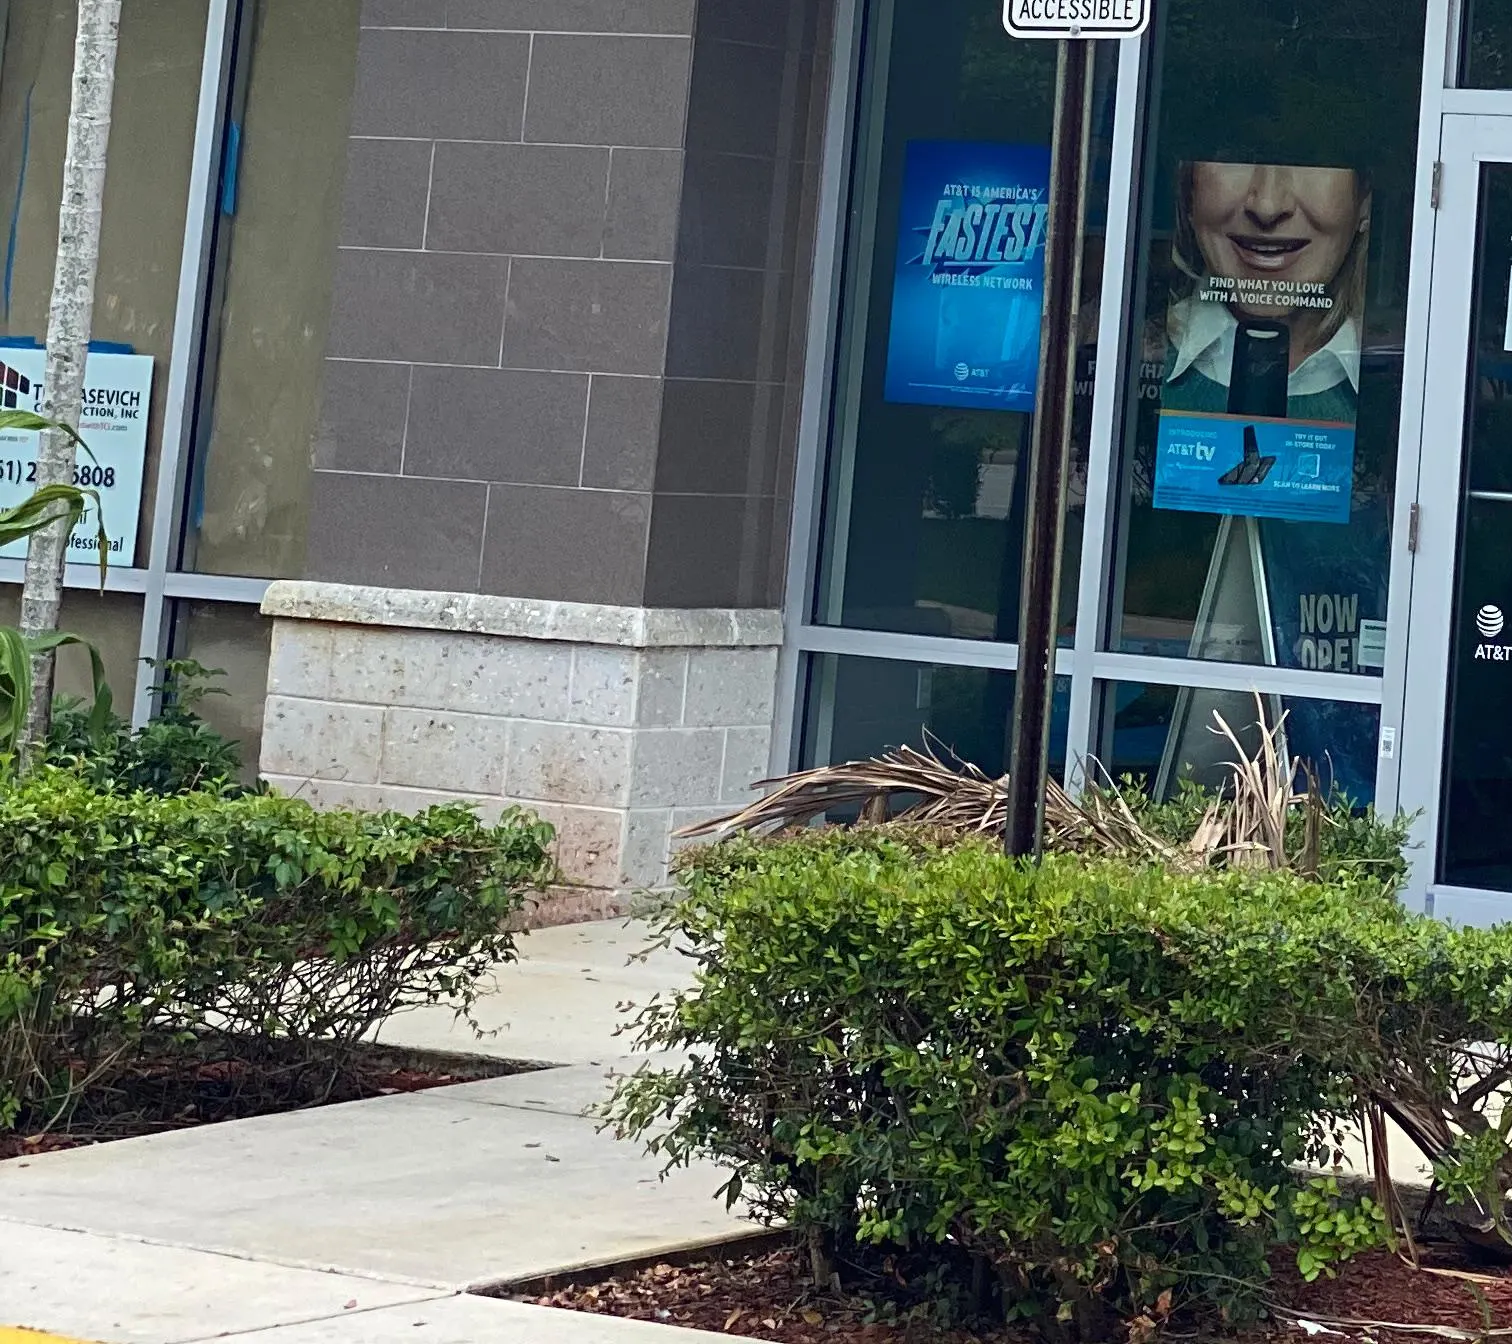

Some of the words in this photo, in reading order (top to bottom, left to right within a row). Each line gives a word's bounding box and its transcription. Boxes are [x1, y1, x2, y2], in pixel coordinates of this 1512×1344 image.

[943, 184, 969, 197] AT&T
[971, 185, 981, 198] IS
[983, 187, 1038, 201] AMERICA'S
[922, 199, 1049, 264] FASTEST
[932, 273, 981, 287] WIRELESS
[983, 276, 1033, 290] NETWORK
[1209, 277, 1235, 289] FIND
[1237, 279, 1269, 291] WHAT
[1271, 281, 1295, 292] YOU
[1296, 282, 1325, 294] LOVE
[1200, 290, 1228, 302] WITH
[1229, 292, 1238, 303] A
[1240, 293, 1273, 305] VOICE
[1275, 295, 1333, 309] COMMAND
[121, 408, 139, 419] INC
[1167, 443, 1195, 456] AT&T
[1195, 441, 1216, 462] tv
[1300, 593, 1359, 634] NOW
[1474, 644, 1512, 661] AT&T
